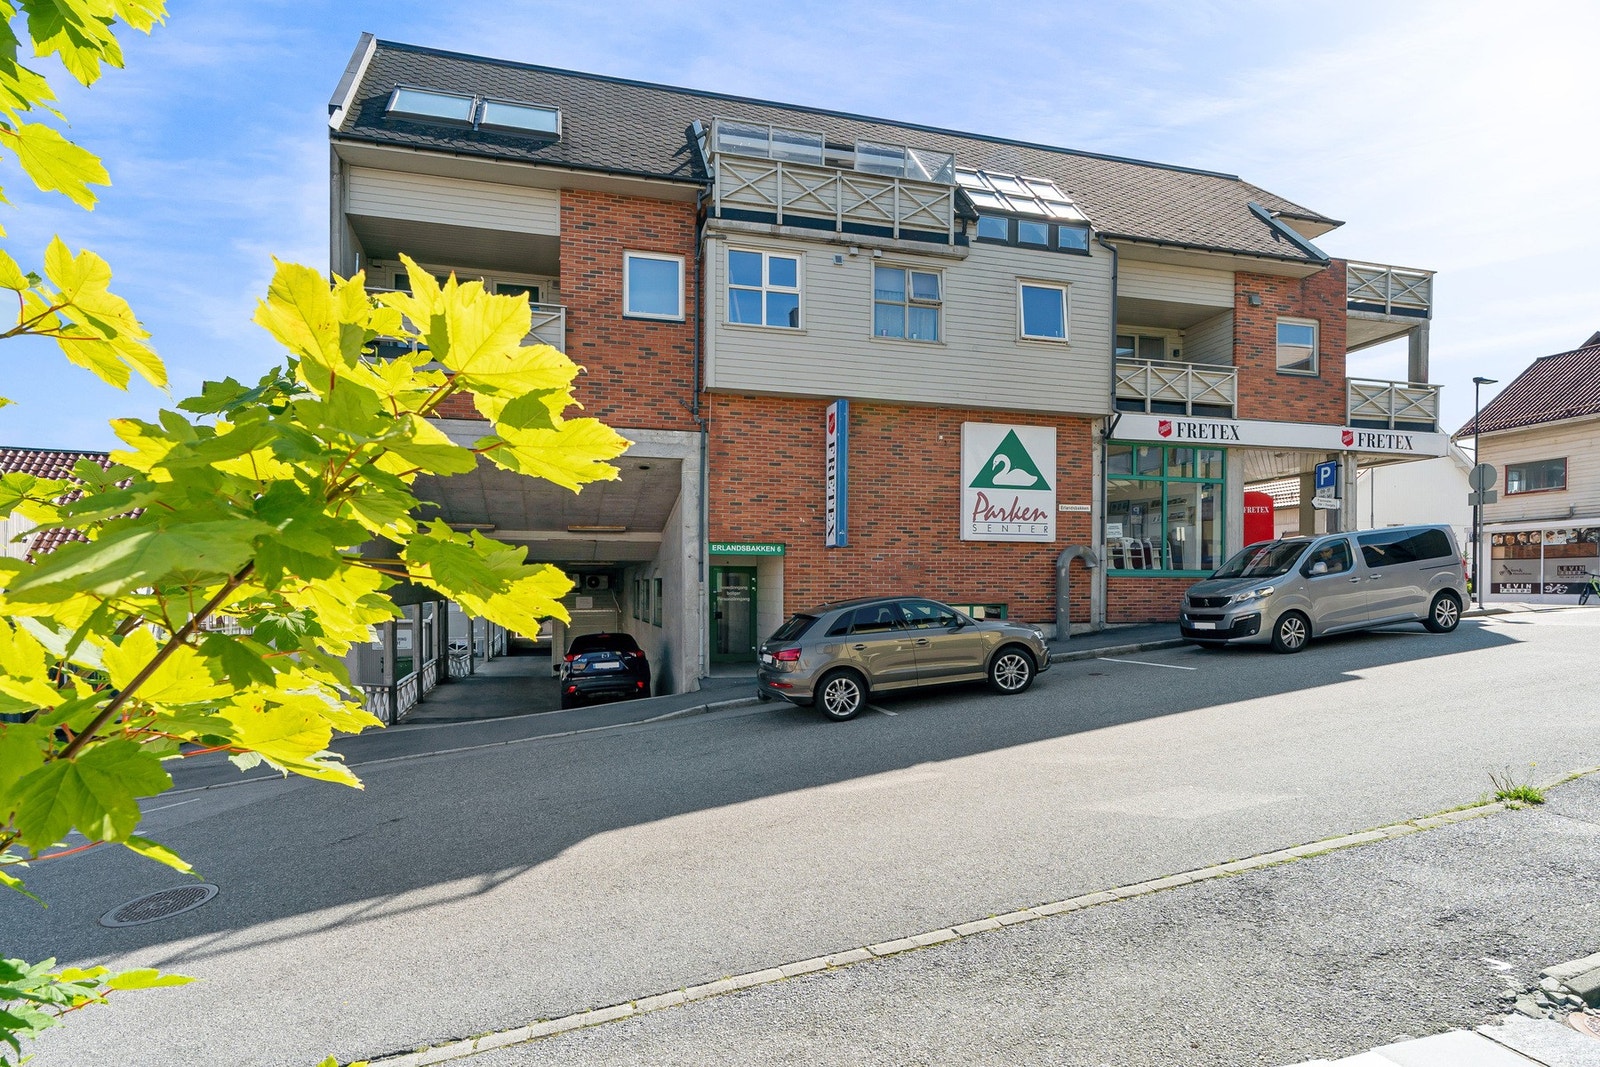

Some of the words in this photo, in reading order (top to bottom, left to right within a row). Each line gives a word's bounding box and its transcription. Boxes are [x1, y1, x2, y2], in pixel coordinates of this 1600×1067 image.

[1177, 422, 1240, 441] FRETEX
[1358, 432, 1413, 450] FRETEX
[1321, 466, 1331, 486] P
[972, 491, 1048, 522] Parken
[1244, 506, 1269, 514] FRETEX
[972, 524, 1048, 533] SENTER
